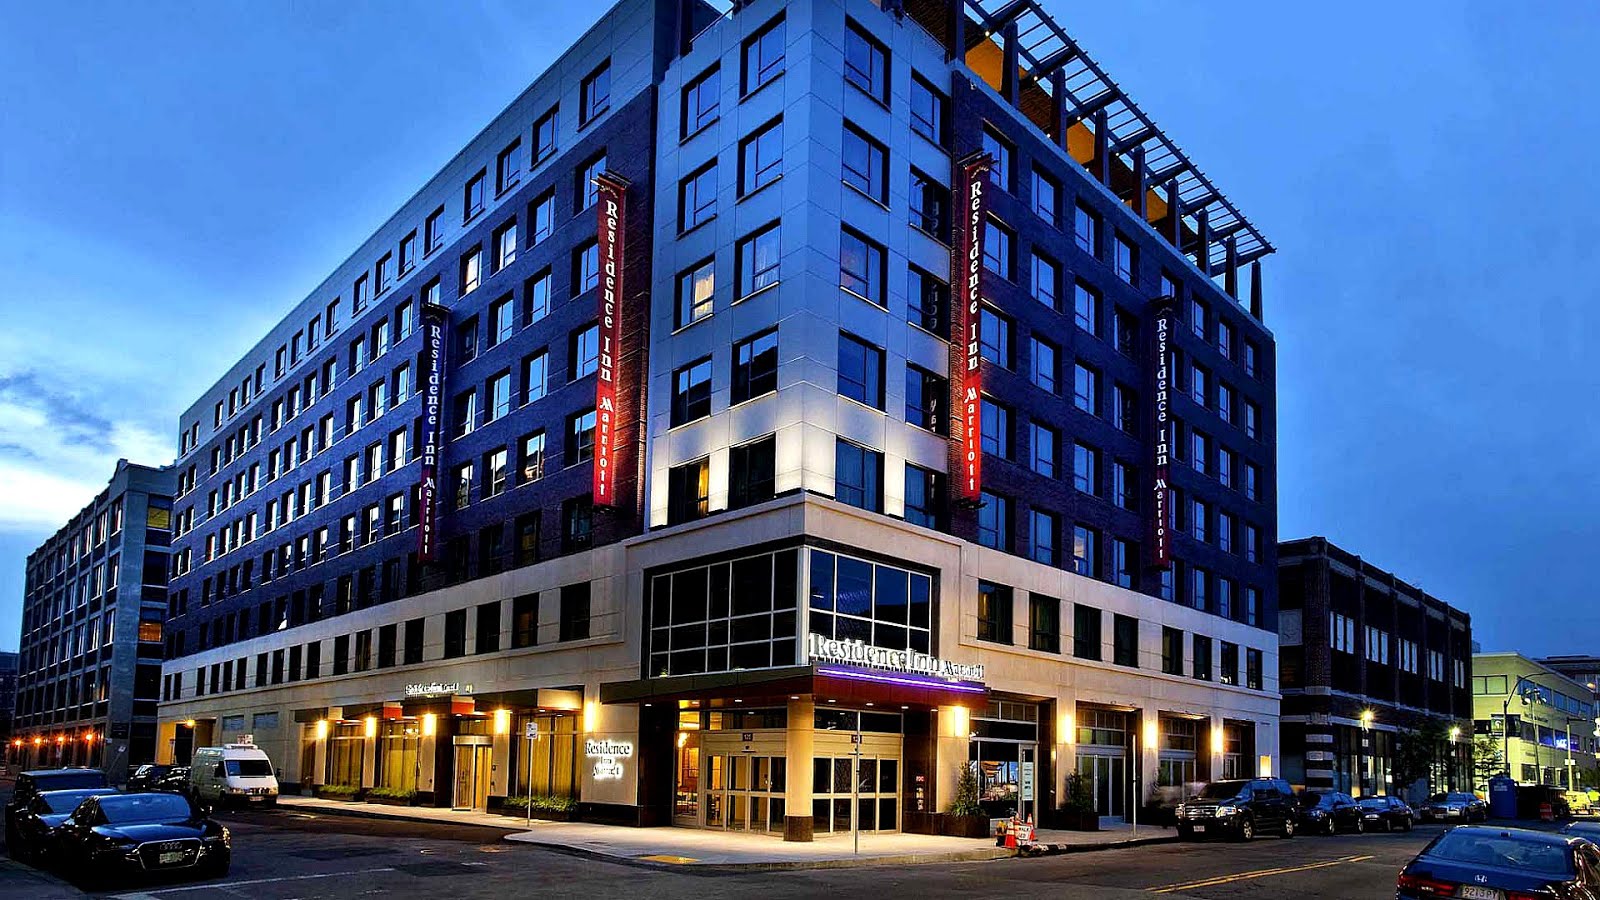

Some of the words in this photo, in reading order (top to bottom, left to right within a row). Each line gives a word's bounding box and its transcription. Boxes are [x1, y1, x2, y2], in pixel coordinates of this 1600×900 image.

[604, 200, 618, 329] Residence
[968, 181, 982, 314] Residence
[427, 325, 441, 425] Residence
[600, 336, 612, 382] Inn
[967, 323, 978, 371] Inn
[1157, 318, 1167, 422] Residence
[425, 431, 435, 465] Inn
[599, 397, 614, 496] Marriott
[964, 386, 977, 491] Marriott
[1157, 429, 1167, 465] Inn
[423, 477, 435, 554] Marriott
[1154, 479, 1167, 559] Marriott
[809, 632, 907, 668] Residence
[906, 648, 940, 672] Inn
[585, 740, 631, 756] Residence
